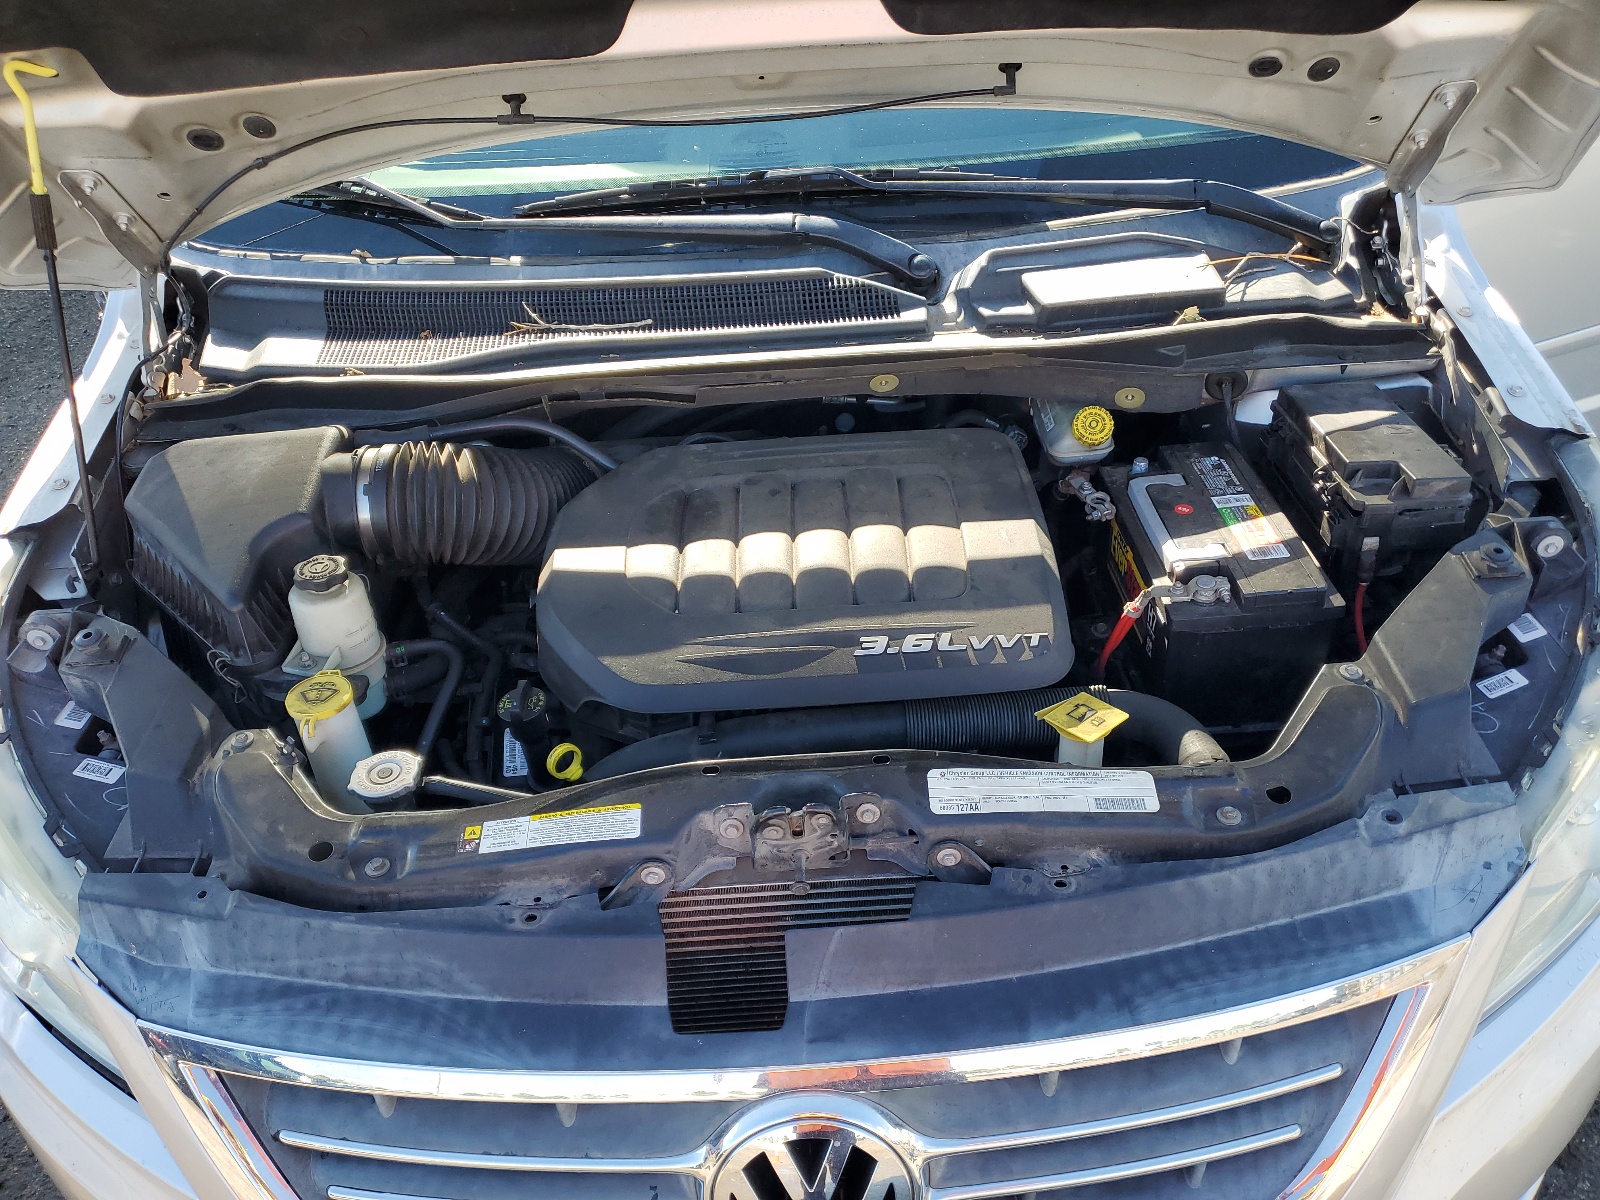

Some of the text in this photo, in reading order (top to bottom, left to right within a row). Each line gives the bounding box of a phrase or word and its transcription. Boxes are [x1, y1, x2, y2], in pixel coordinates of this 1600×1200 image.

[854, 632, 1049, 656] 3.6L VVT
[956, 803, 980, 812] 127AA
